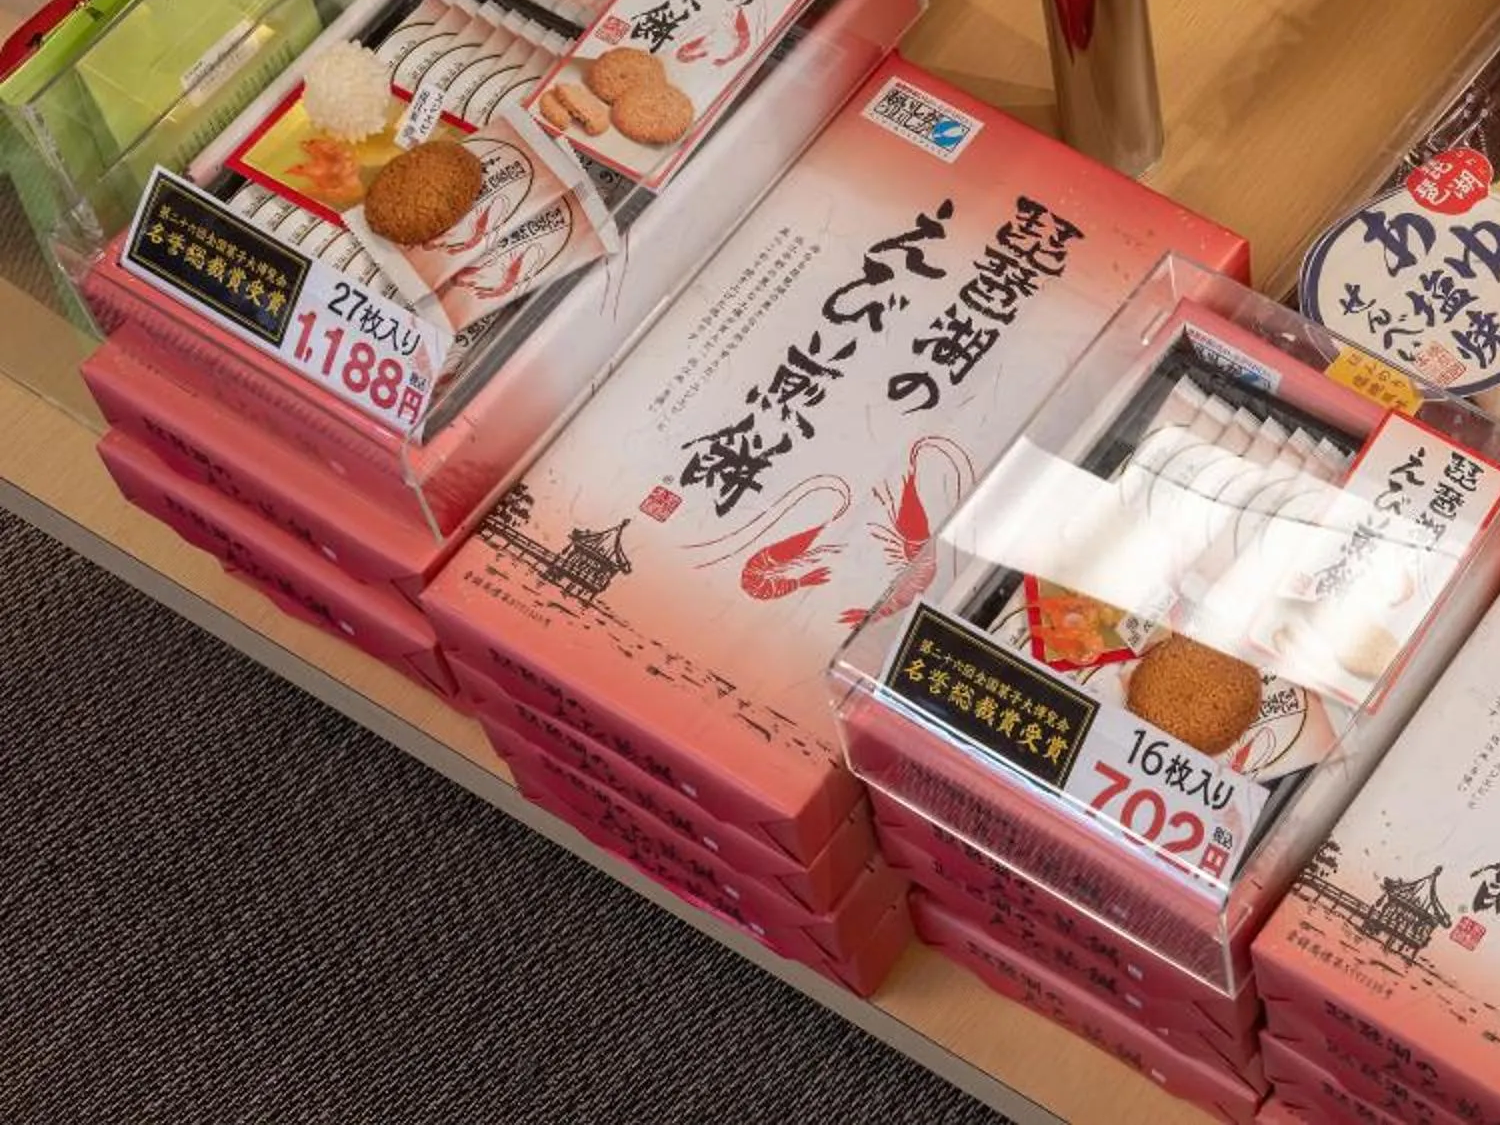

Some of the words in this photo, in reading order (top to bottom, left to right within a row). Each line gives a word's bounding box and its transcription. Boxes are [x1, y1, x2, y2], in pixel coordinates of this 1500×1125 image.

[146, 225, 289, 318] 名誉総裁賞受賞
[327, 281, 423, 357] 27枚入り
[888, 196, 1085, 412] 琵琶湖の
[294, 310, 424, 425] 1,188円
[680, 199, 955, 517] えび煎餅
[1339, 281, 1423, 365] せんべい
[902, 658, 1070, 766] 名誉総裁賞受賞
[1127, 728, 1236, 813] 16枚入り
